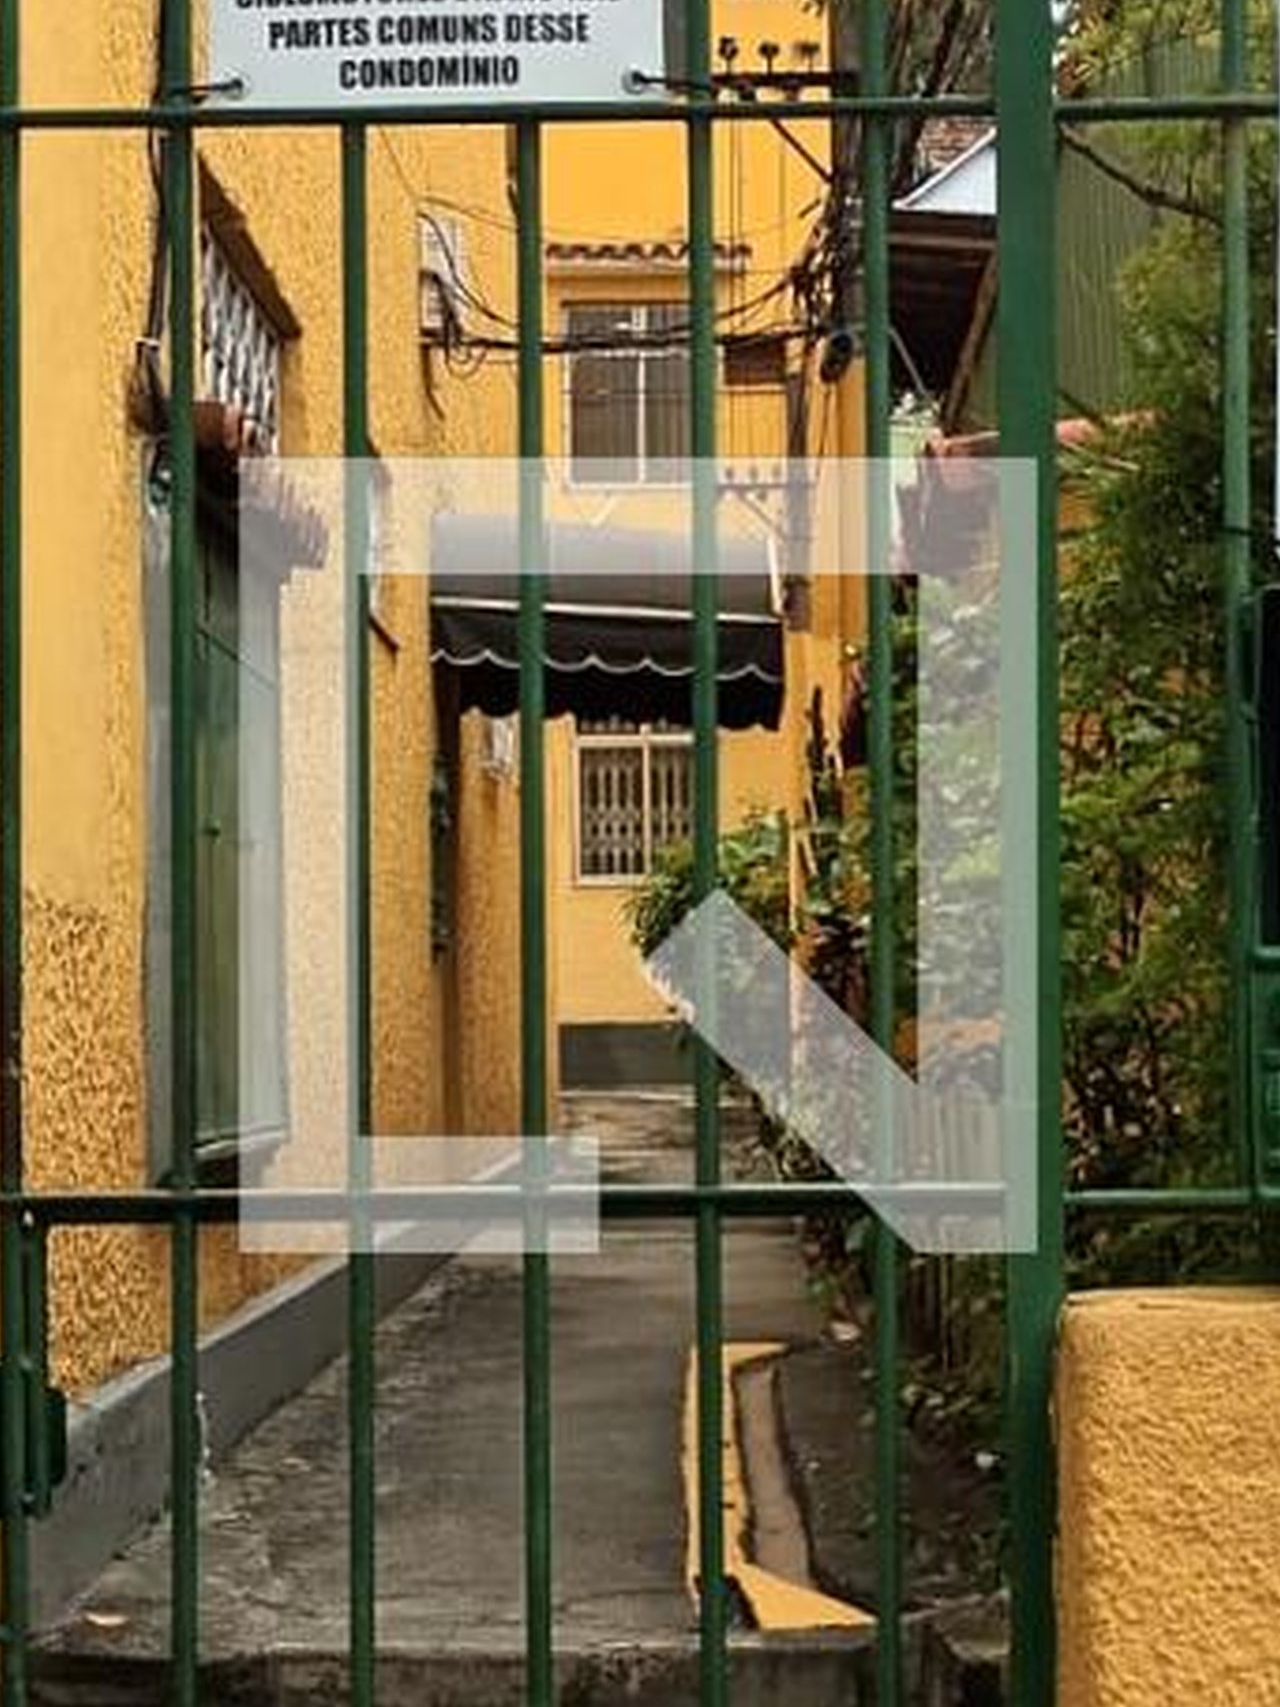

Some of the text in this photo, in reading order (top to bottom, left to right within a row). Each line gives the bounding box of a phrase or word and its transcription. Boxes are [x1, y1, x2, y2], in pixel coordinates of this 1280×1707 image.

[269, 13, 591, 49] PARTES COMUNS DESSE
[338, 52, 521, 89] CONDOMÍNIO
